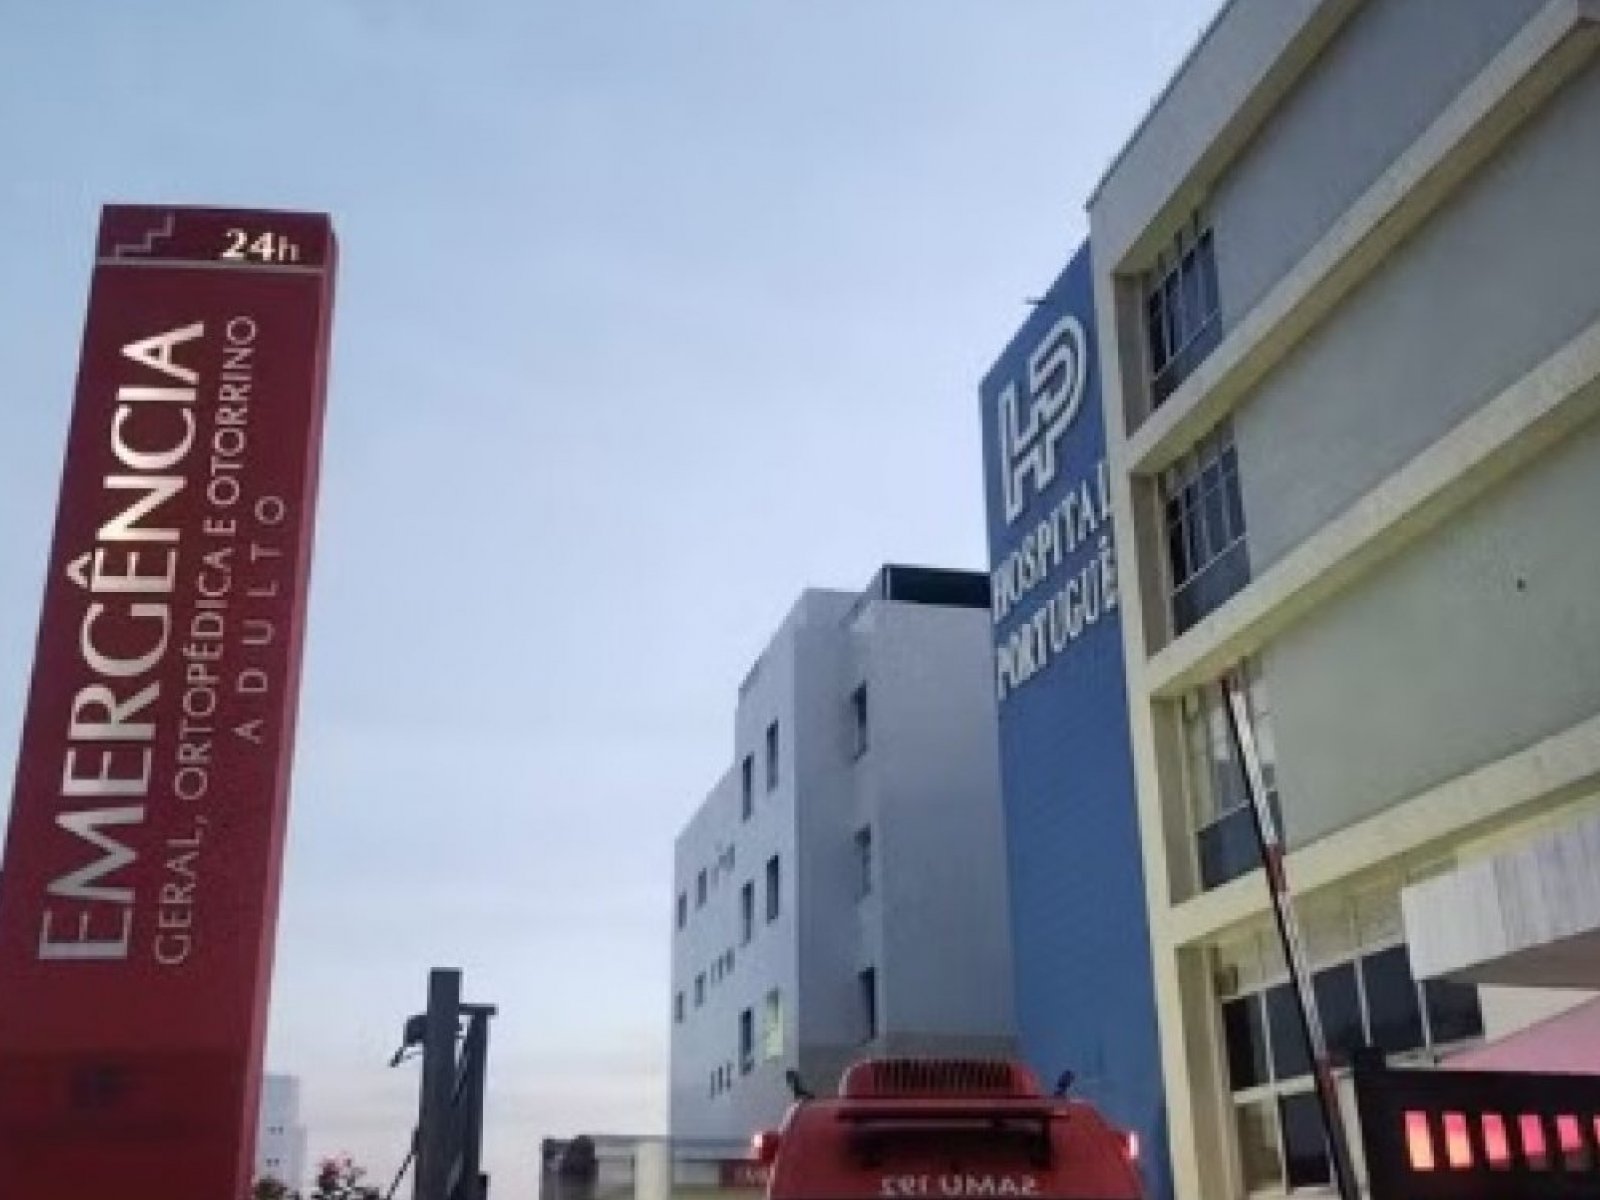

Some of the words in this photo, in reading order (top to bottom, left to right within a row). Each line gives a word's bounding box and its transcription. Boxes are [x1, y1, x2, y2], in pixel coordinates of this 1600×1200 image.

[221, 227, 299, 261] 24h
[206, 315, 257, 507] OTORRINO
[202, 518, 237, 537] E
[37, 321, 205, 960] EMERGÊNCIA
[173, 547, 235, 801] ORTOPÉDICA
[231, 495, 286, 745] ADULTO
[997, 534, 1118, 701] PORTUGUÊ
[153, 814, 208, 965] GERAL,
